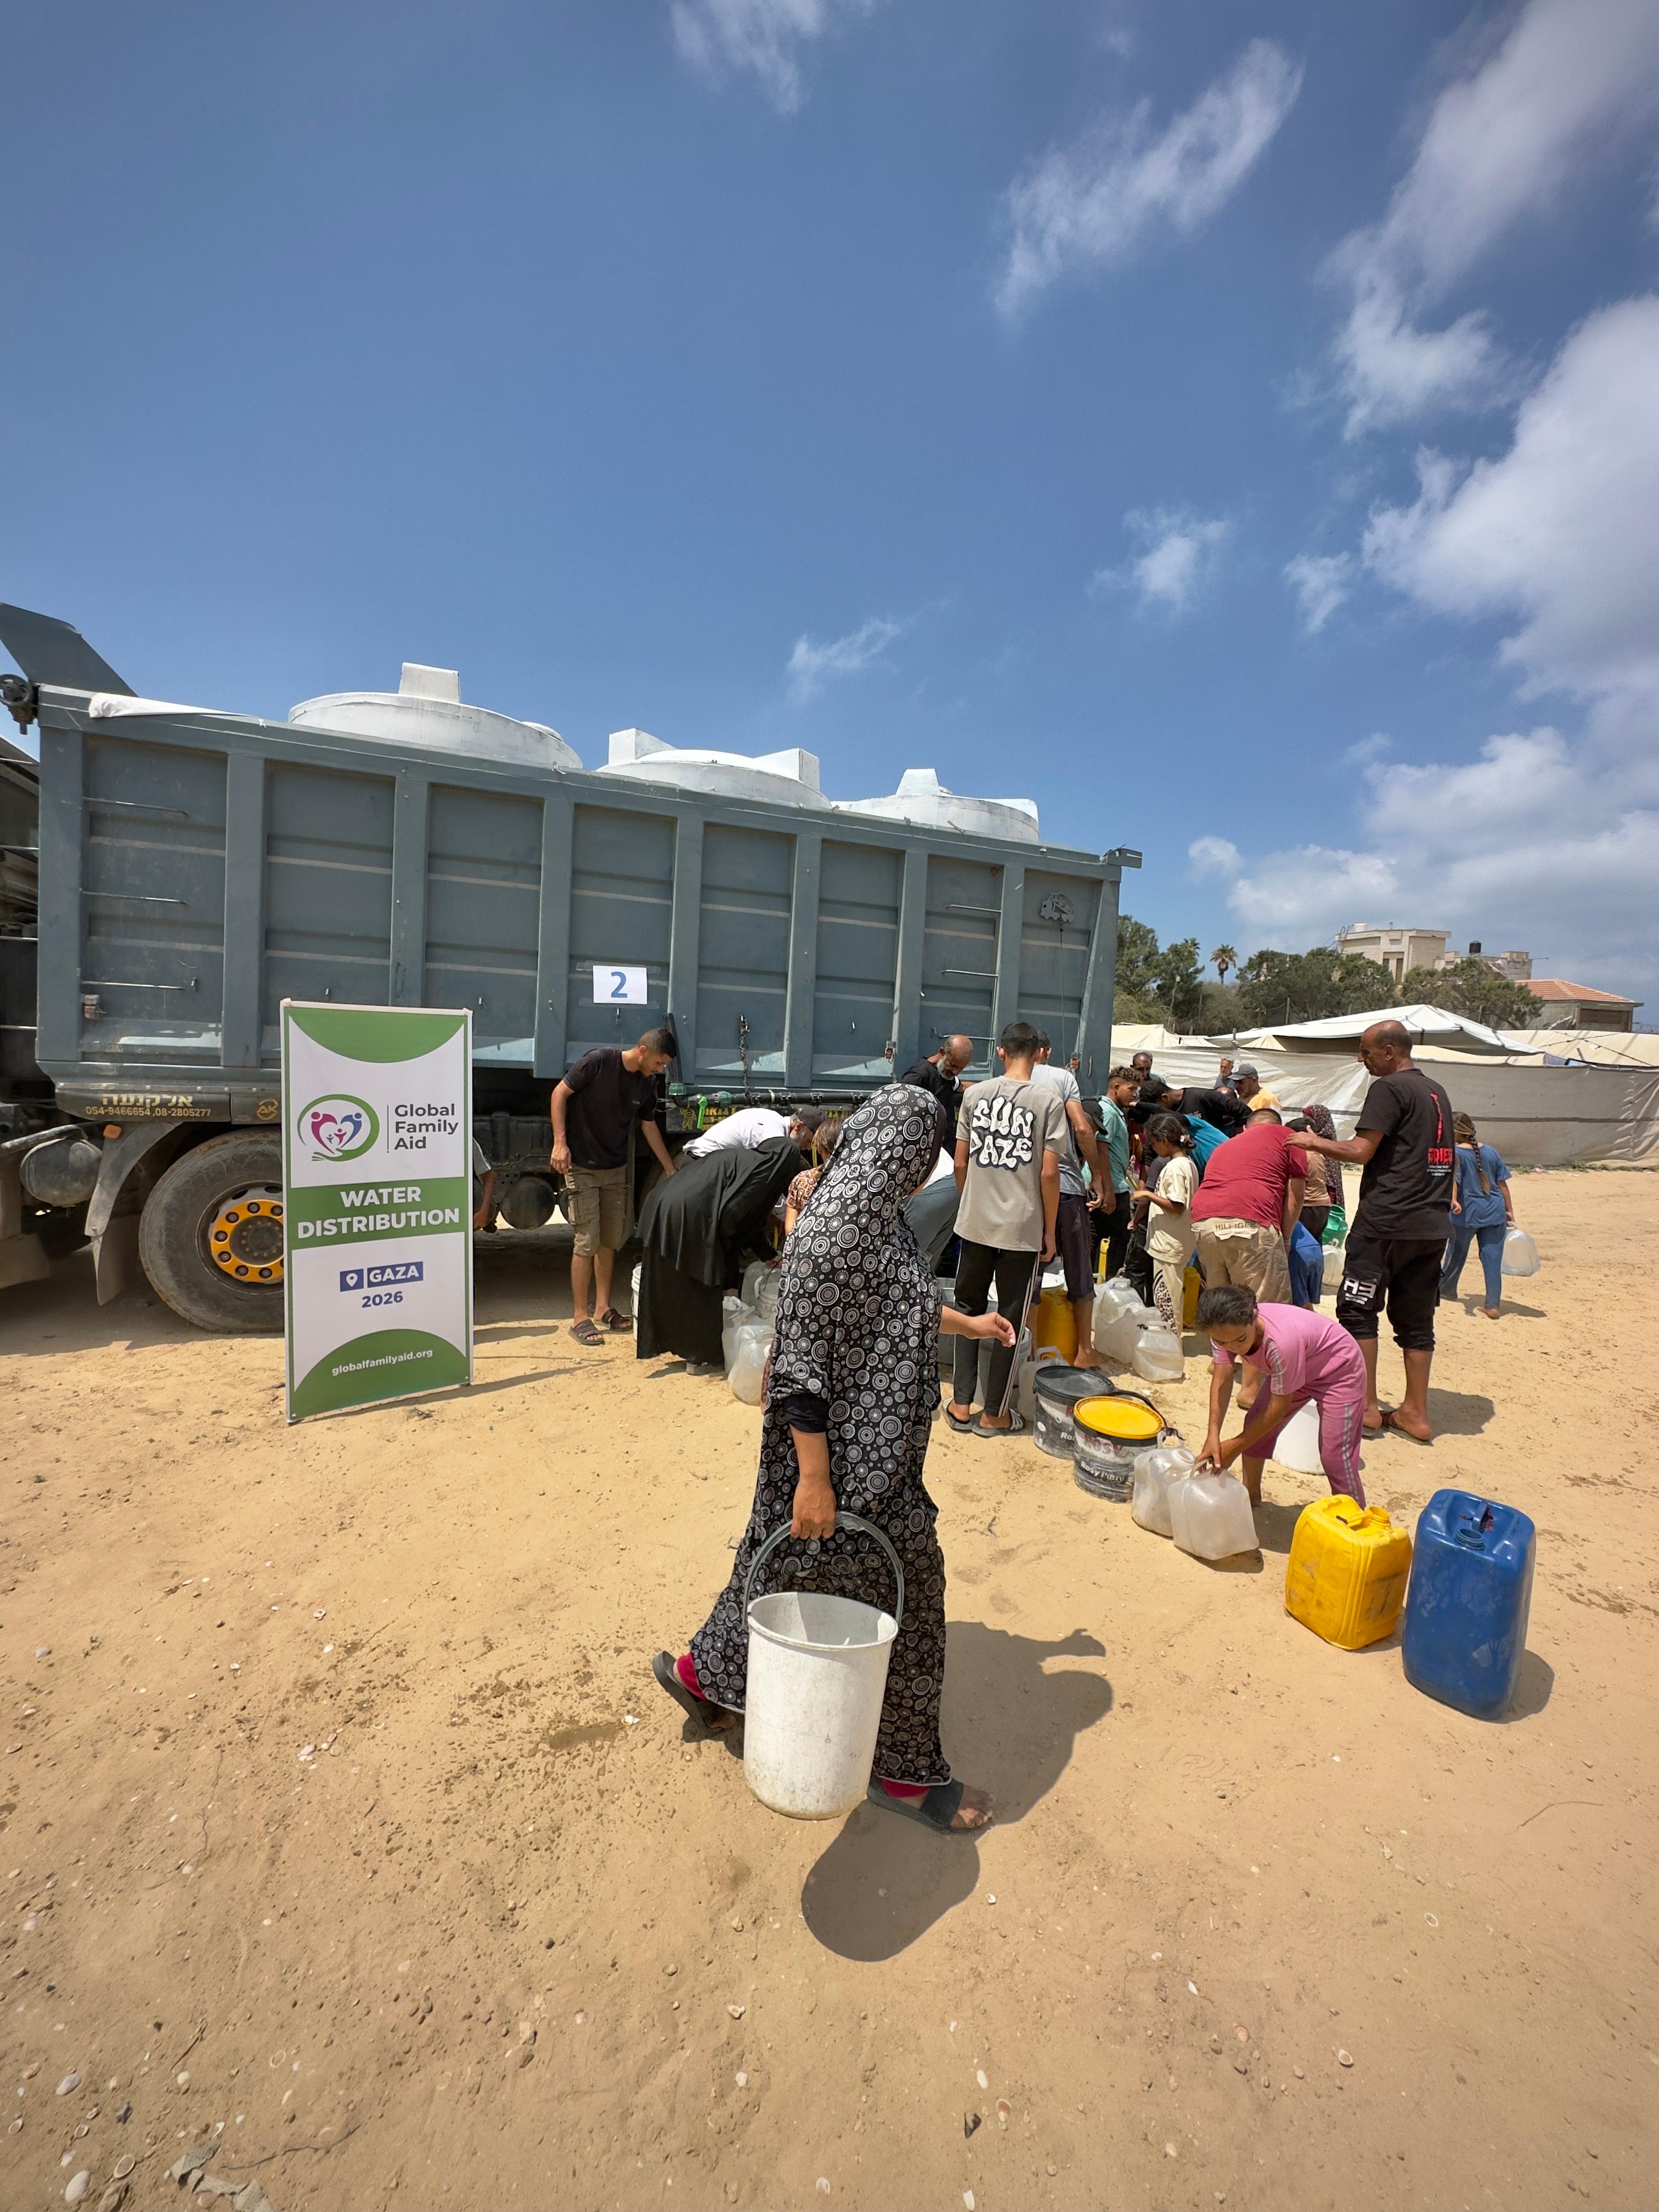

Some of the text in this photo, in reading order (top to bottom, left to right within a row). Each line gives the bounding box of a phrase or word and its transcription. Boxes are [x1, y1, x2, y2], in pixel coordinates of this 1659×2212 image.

[611, 971, 628, 998] 2
[86, 1106, 150, 1116] 054-9466654
[394, 1103, 455, 1117] Global
[972, 1096, 1034, 1138] SUN
[395, 1119, 459, 1135] Family
[394, 1136, 426, 1150] Aid
[969, 1130, 1032, 1169] DAZE
[340, 1187, 421, 1207] WATER
[298, 1208, 459, 1239] DISTRIBUTION
[1215, 1221, 1256, 1230] HILFIGER
[369, 1265, 419, 1283] GAZA
[362, 1291, 403, 1308] 2026
[332, 1350, 433, 1376] globalfamilyaid.org
[1060, 1432, 1075, 1441] Ro
[1081, 1461, 1099, 1476] Rosy
